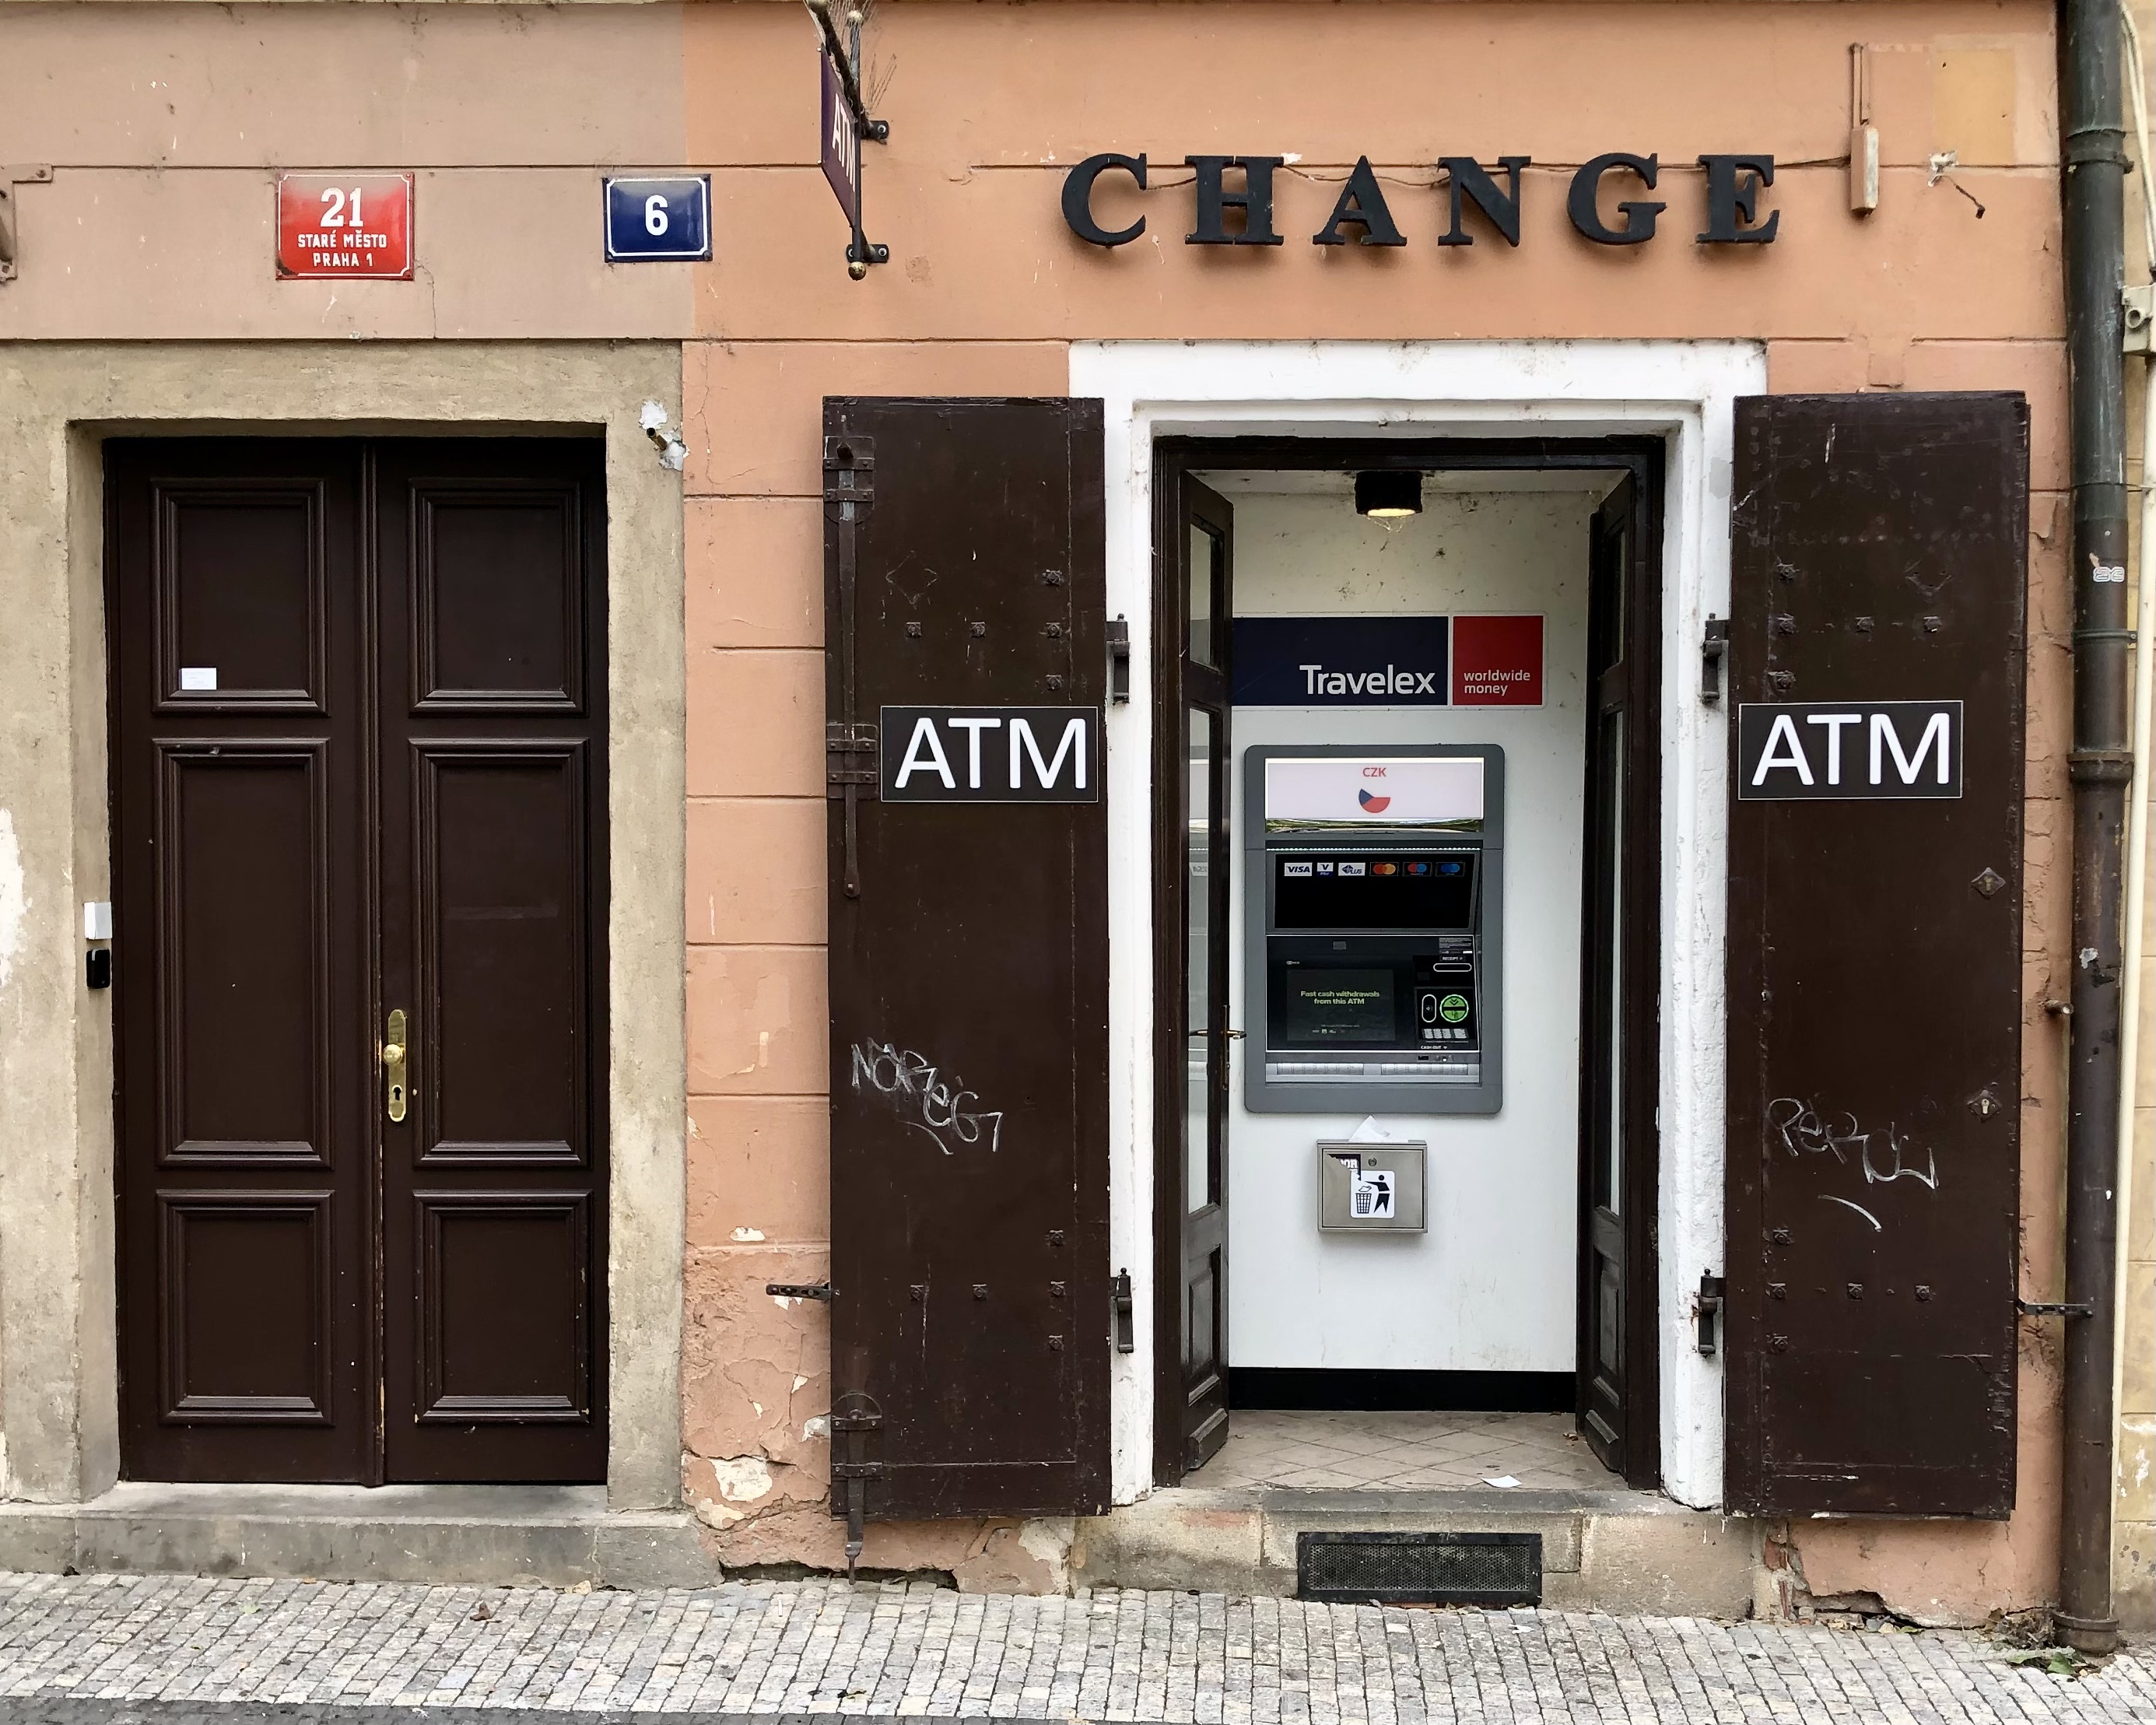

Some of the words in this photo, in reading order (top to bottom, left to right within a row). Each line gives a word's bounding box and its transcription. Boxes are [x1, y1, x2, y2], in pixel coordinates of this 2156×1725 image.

[320, 187, 364, 227] 21
[645, 194, 668, 236] 6
[1060, 153, 1780, 247] CHANGE
[297, 229, 337, 248] STARÉ
[343, 229, 387, 248] MĚSTO
[313, 252, 359, 267] PRAHA
[366, 252, 373, 267] 1
[1299, 664, 1436, 696] Travelex
[1464, 669, 1530, 682] worldwide
[1464, 683, 1509, 696] money
[895, 717, 1086, 789] ATM
[1751, 713, 1950, 786] ATM
[1362, 767, 1387, 777] CZK
